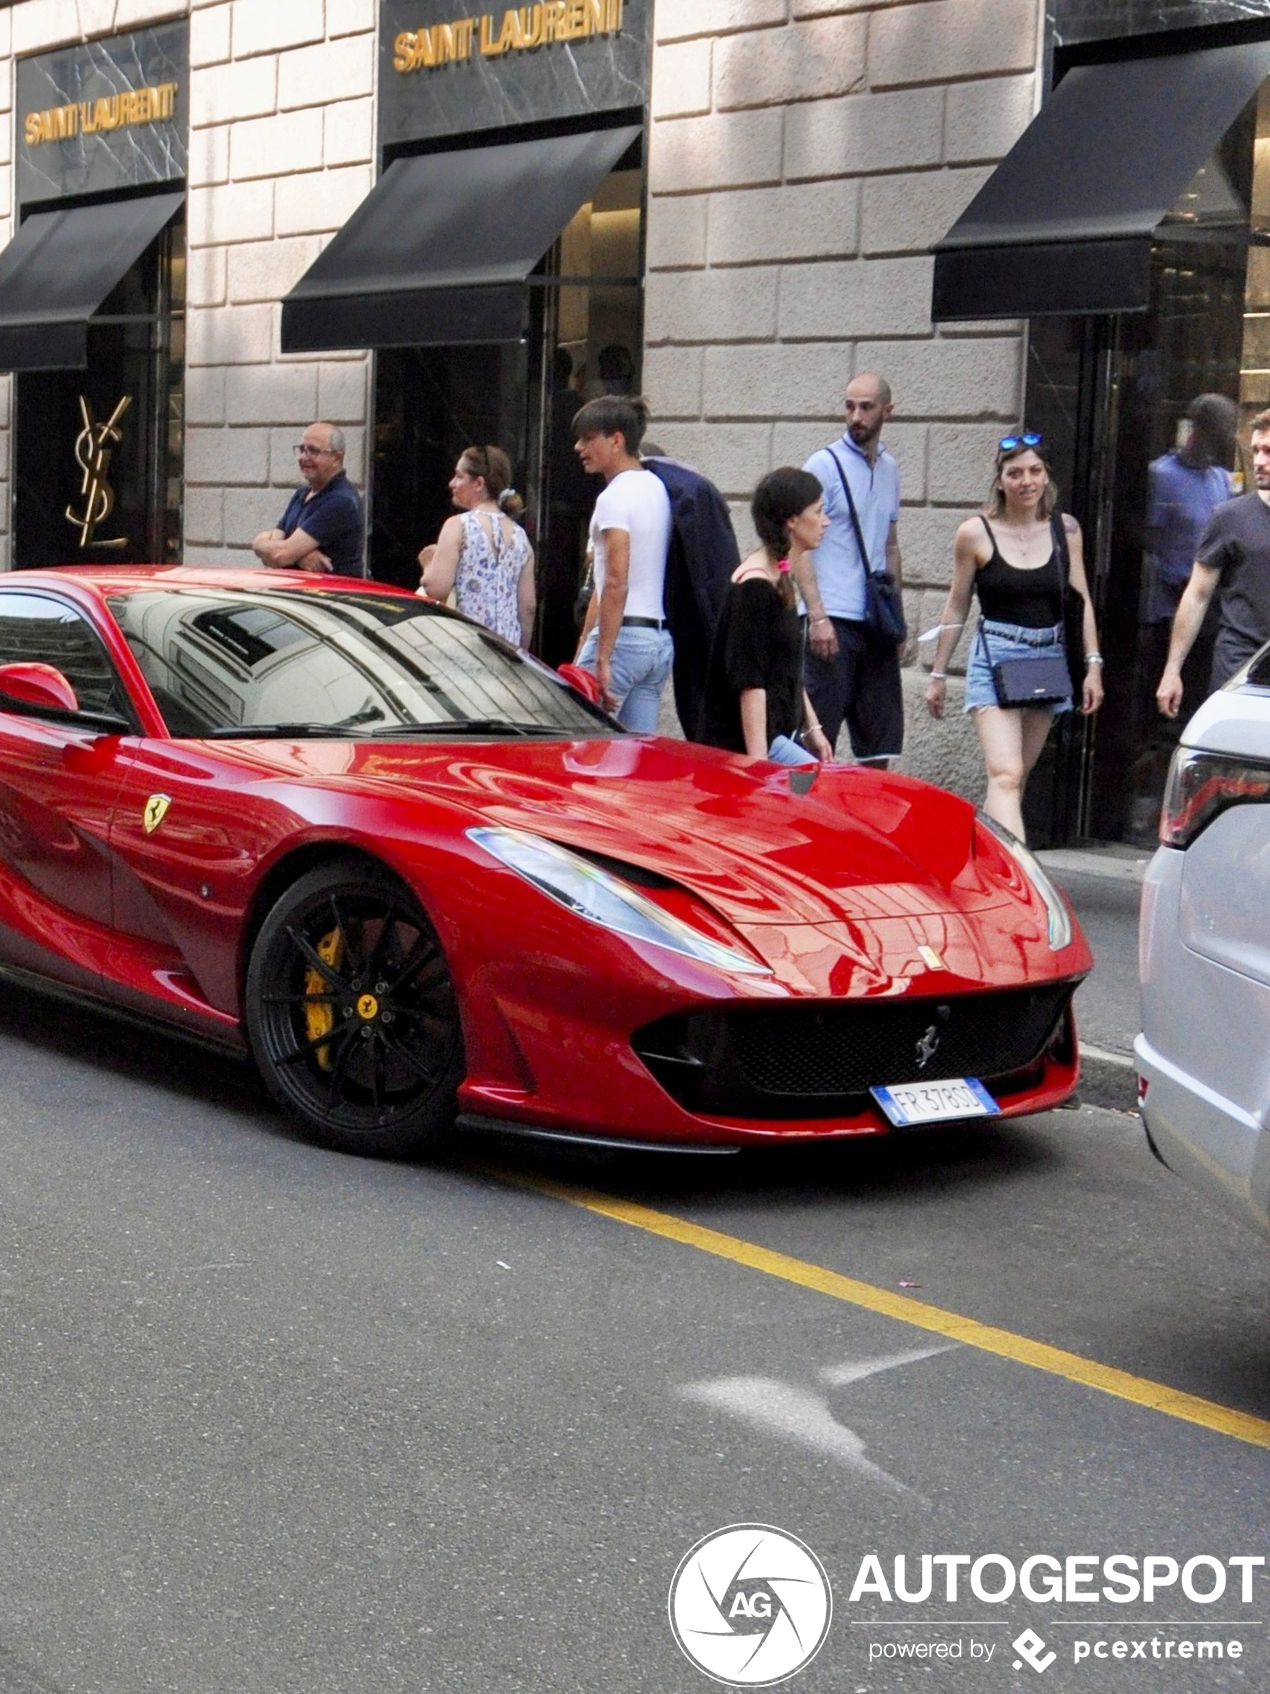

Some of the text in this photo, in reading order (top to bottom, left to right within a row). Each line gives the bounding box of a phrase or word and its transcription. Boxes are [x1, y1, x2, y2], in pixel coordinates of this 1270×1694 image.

[394, 0, 624, 72] SAINT LAURENT
[25, 82, 175, 144] SAINT LAURENT
